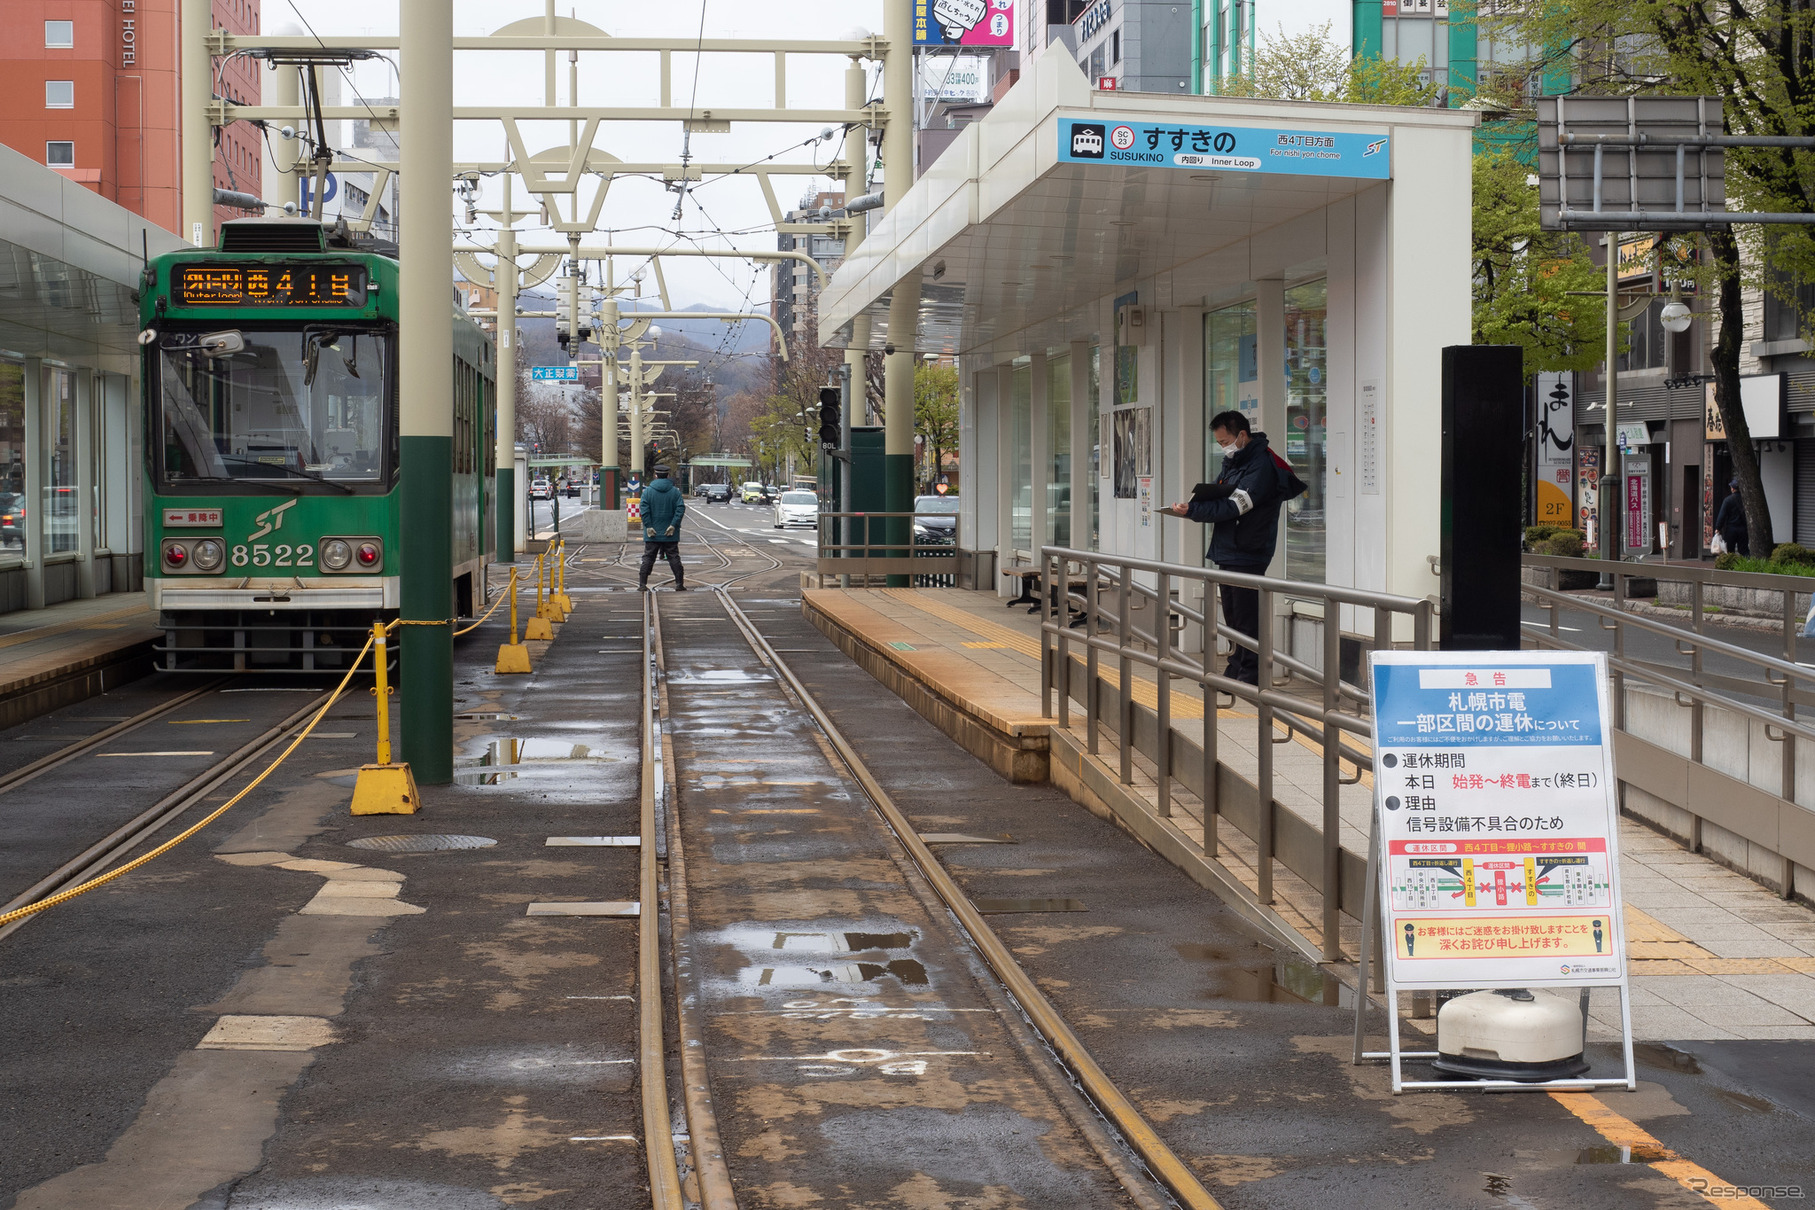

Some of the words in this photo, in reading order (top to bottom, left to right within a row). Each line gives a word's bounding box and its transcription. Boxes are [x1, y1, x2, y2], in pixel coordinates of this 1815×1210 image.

[995, 14, 1003, 36] つまり
[122, 19, 135, 68] HOTEL
[1117, 130, 1129, 138] SC
[1118, 138, 1128, 146] 23
[1143, 127, 1236, 154] すすきの
[1277, 134, 1335, 148] 西4丁目方面
[1110, 151, 1164, 163] SUSUKINO
[1181, 156, 1204, 165] 内回り
[1211, 157, 1232, 166] Inner
[1234, 159, 1255, 168] Loop
[1269, 148, 1283, 156] For
[1283, 149, 1300, 158] nishi
[1301, 150, 1315, 160] yon
[1316, 150, 1341, 160] chome
[1630, 478, 1639, 509] 北海道バス
[1545, 503, 1565, 515] 2F
[247, 498, 298, 543] ST
[231, 544, 314, 567] 8522
[1448, 692, 1527, 712] 札幌市電
[1396, 712, 1580, 733] 一部区間の運休について
[1402, 753, 1466, 769] 運休期間
[1404, 774, 1435, 790] 本日
[1404, 795, 1436, 811] 理由
[1406, 815, 1564, 833] 信号設備不具合のため
[1412, 844, 1448, 852] 運休区間
[1465, 869, 1474, 898] 西4丁目
[1527, 868, 1535, 897] すすきの
[1417, 924, 1588, 937] お客様にはご迷惑をお掛け致しますことを
[1439, 937, 1569, 951] 深くお詫び申し上げます。
